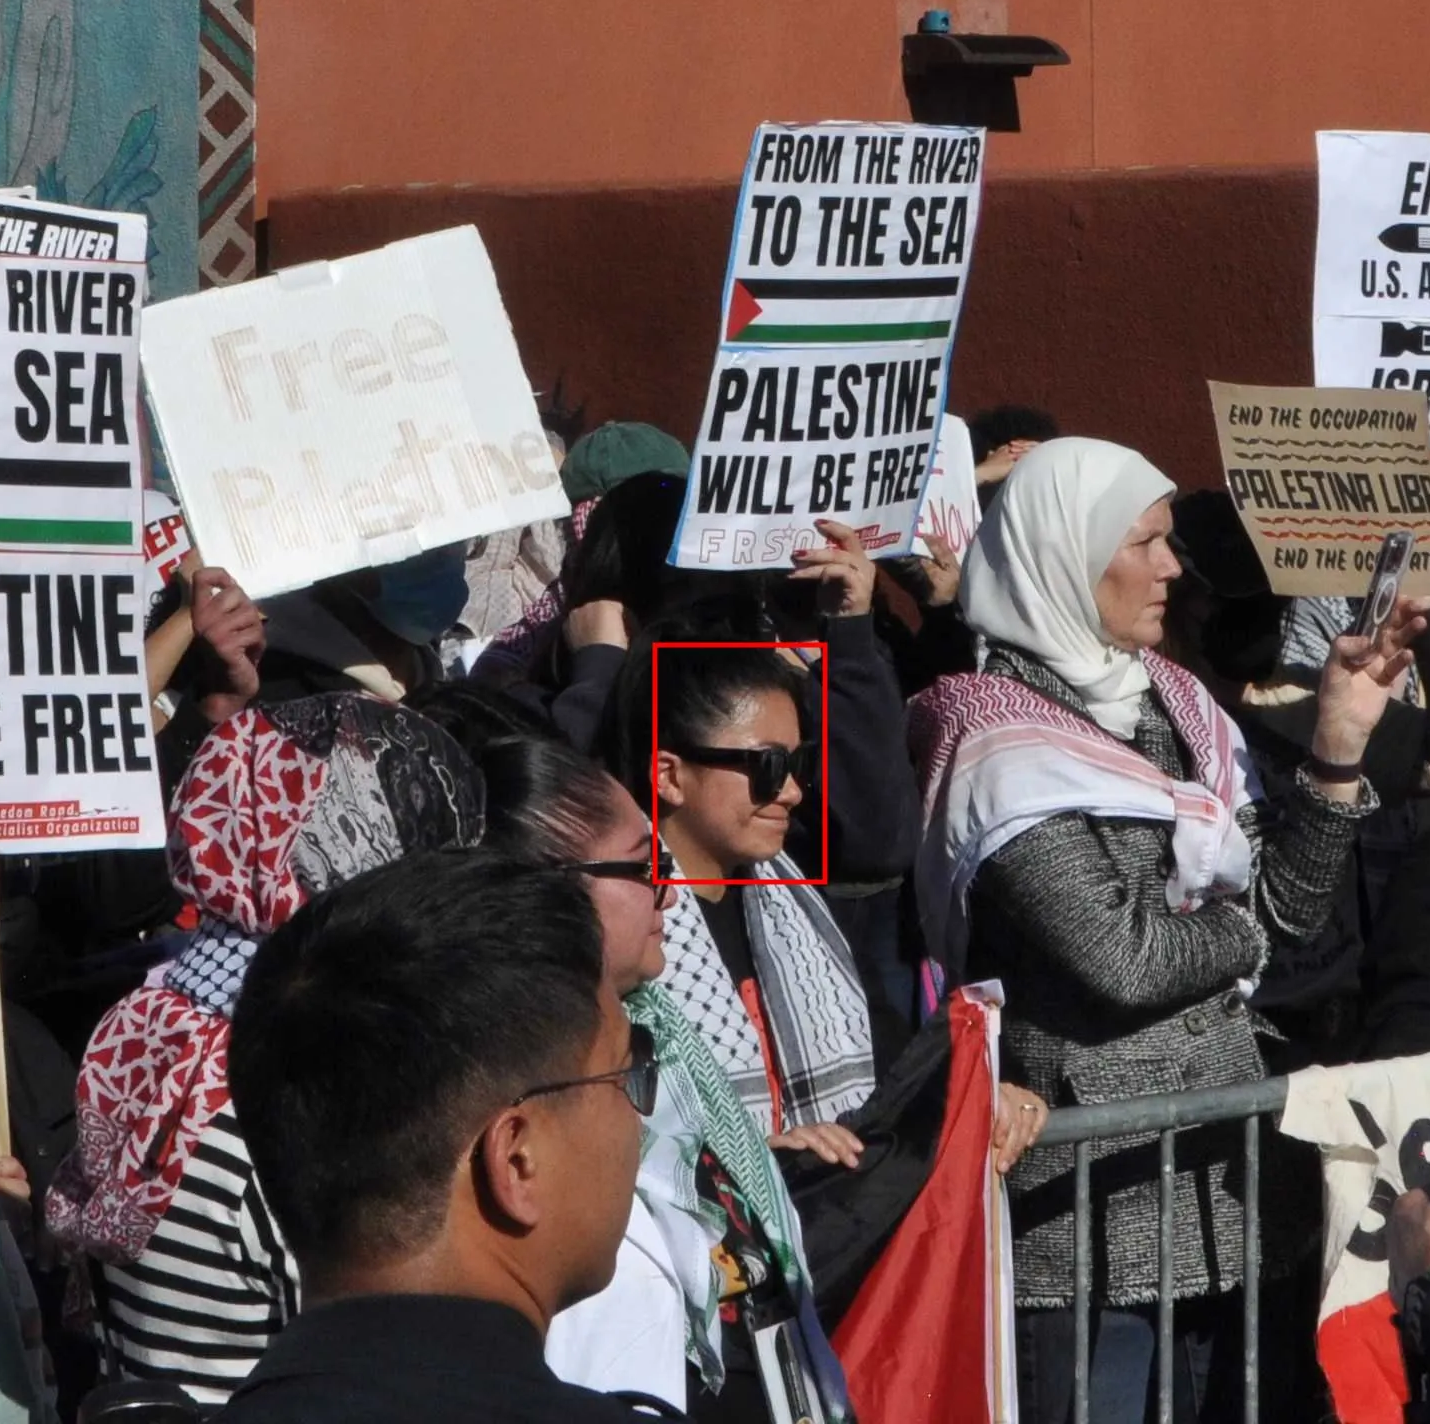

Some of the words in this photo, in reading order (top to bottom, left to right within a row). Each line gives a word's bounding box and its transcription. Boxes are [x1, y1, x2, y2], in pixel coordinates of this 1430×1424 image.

[754, 134, 844, 184] FROM
[853, 136, 903, 185] THE
[912, 137, 980, 183] RIVER
[38, 224, 114, 260] RIVER
[748, 194, 802, 267] TO
[816, 196, 891, 267] THE
[899, 195, 968, 266] SEA
[8, 264, 136, 336] RIVER
[1361, 260, 1408, 298] U.S.
[14, 349, 129, 445] SEA
[211, 313, 459, 422] Free
[708, 357, 941, 442] PALESTINE
[1229, 404, 1262, 426] END
[1269, 407, 1302, 428] THE
[1310, 408, 1416, 432] OCCUPATION
[697, 455, 794, 515] WILL
[808, 453, 856, 513] BE
[862, 443, 930, 509] FREE
[1227, 469, 1379, 513] PALESTINA
[1274, 547, 1308, 569] END
[1315, 549, 1347, 570] THE
[23, 693, 152, 775] FREE
[46, 819, 137, 835] Organization
